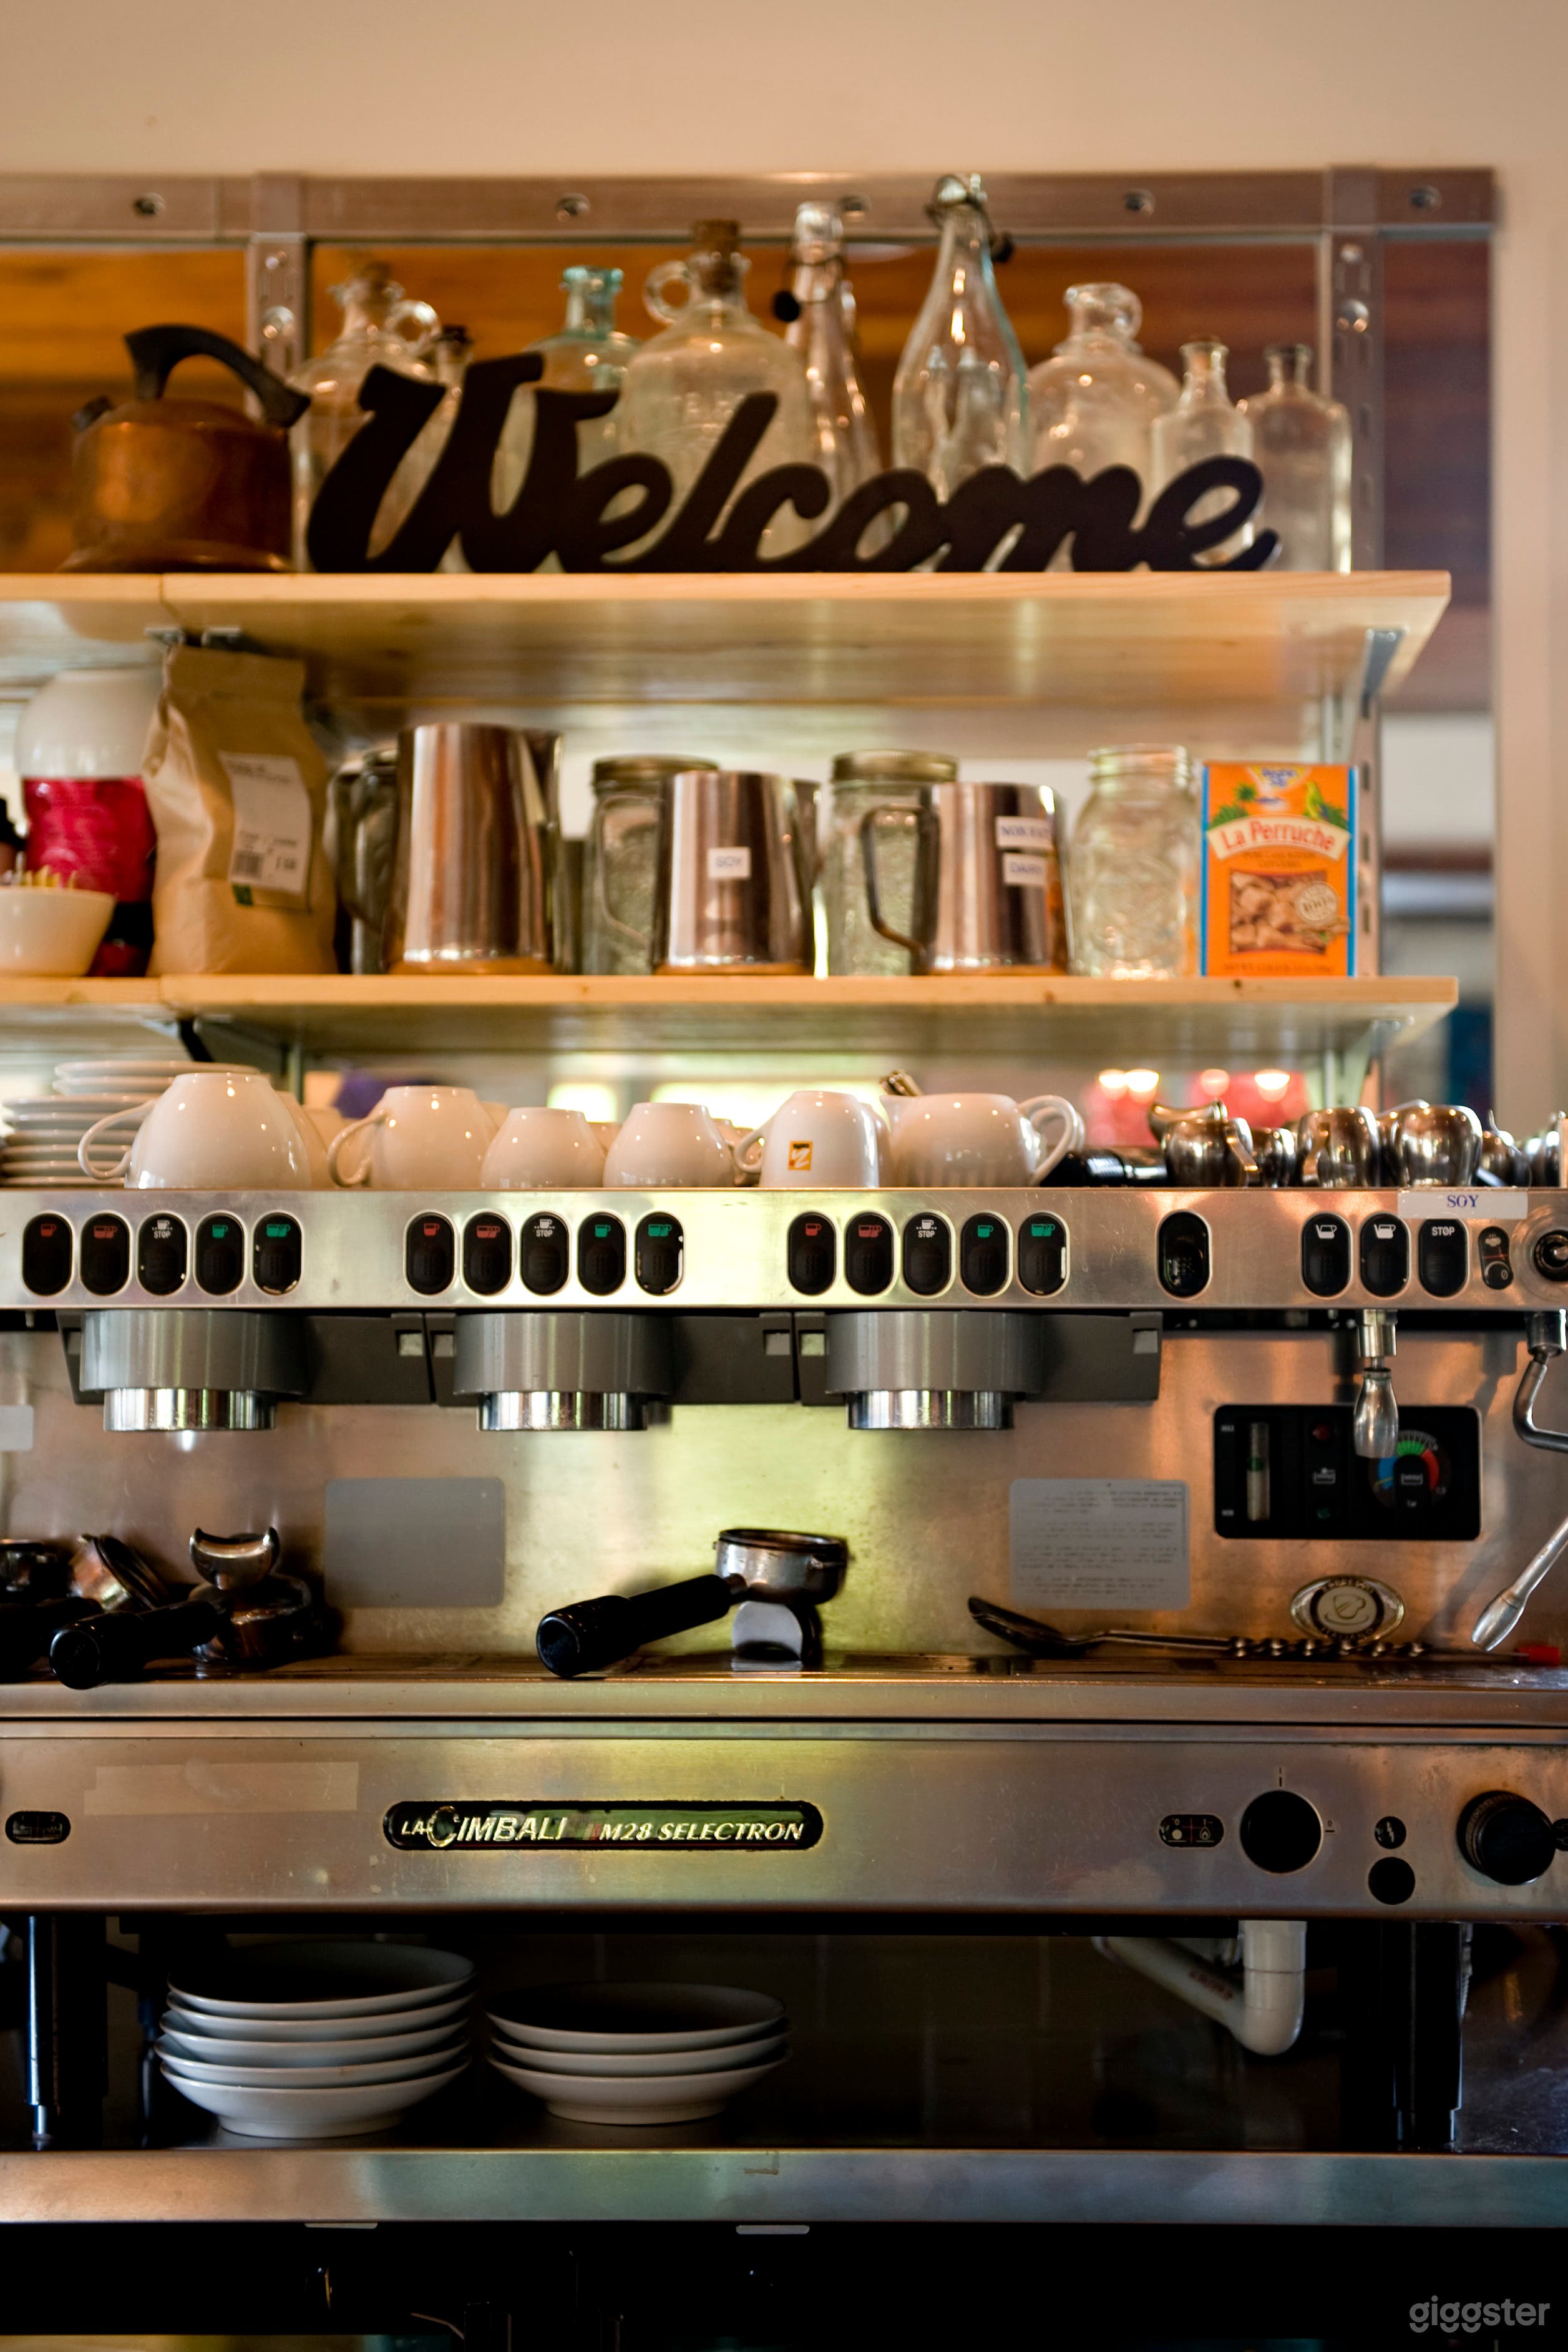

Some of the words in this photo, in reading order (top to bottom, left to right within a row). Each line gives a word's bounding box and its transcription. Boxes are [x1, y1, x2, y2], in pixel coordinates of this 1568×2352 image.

[308, 351, 1280, 574] Welcome
[1220, 829, 1246, 849] La
[1249, 819, 1335, 850] Perruche
[1446, 1194, 1479, 1208] SOY
[153, 1231, 171, 1239] STOP
[535, 1229, 553, 1237] STOP
[918, 1230, 935, 1238] STOP
[1432, 1226, 1455, 1236] STOP
[401, 1820, 427, 1835] LA
[427, 1805, 567, 1848] CIMBALI
[598, 1822, 653, 1841] M28
[658, 1822, 804, 1841] SELECTRON
